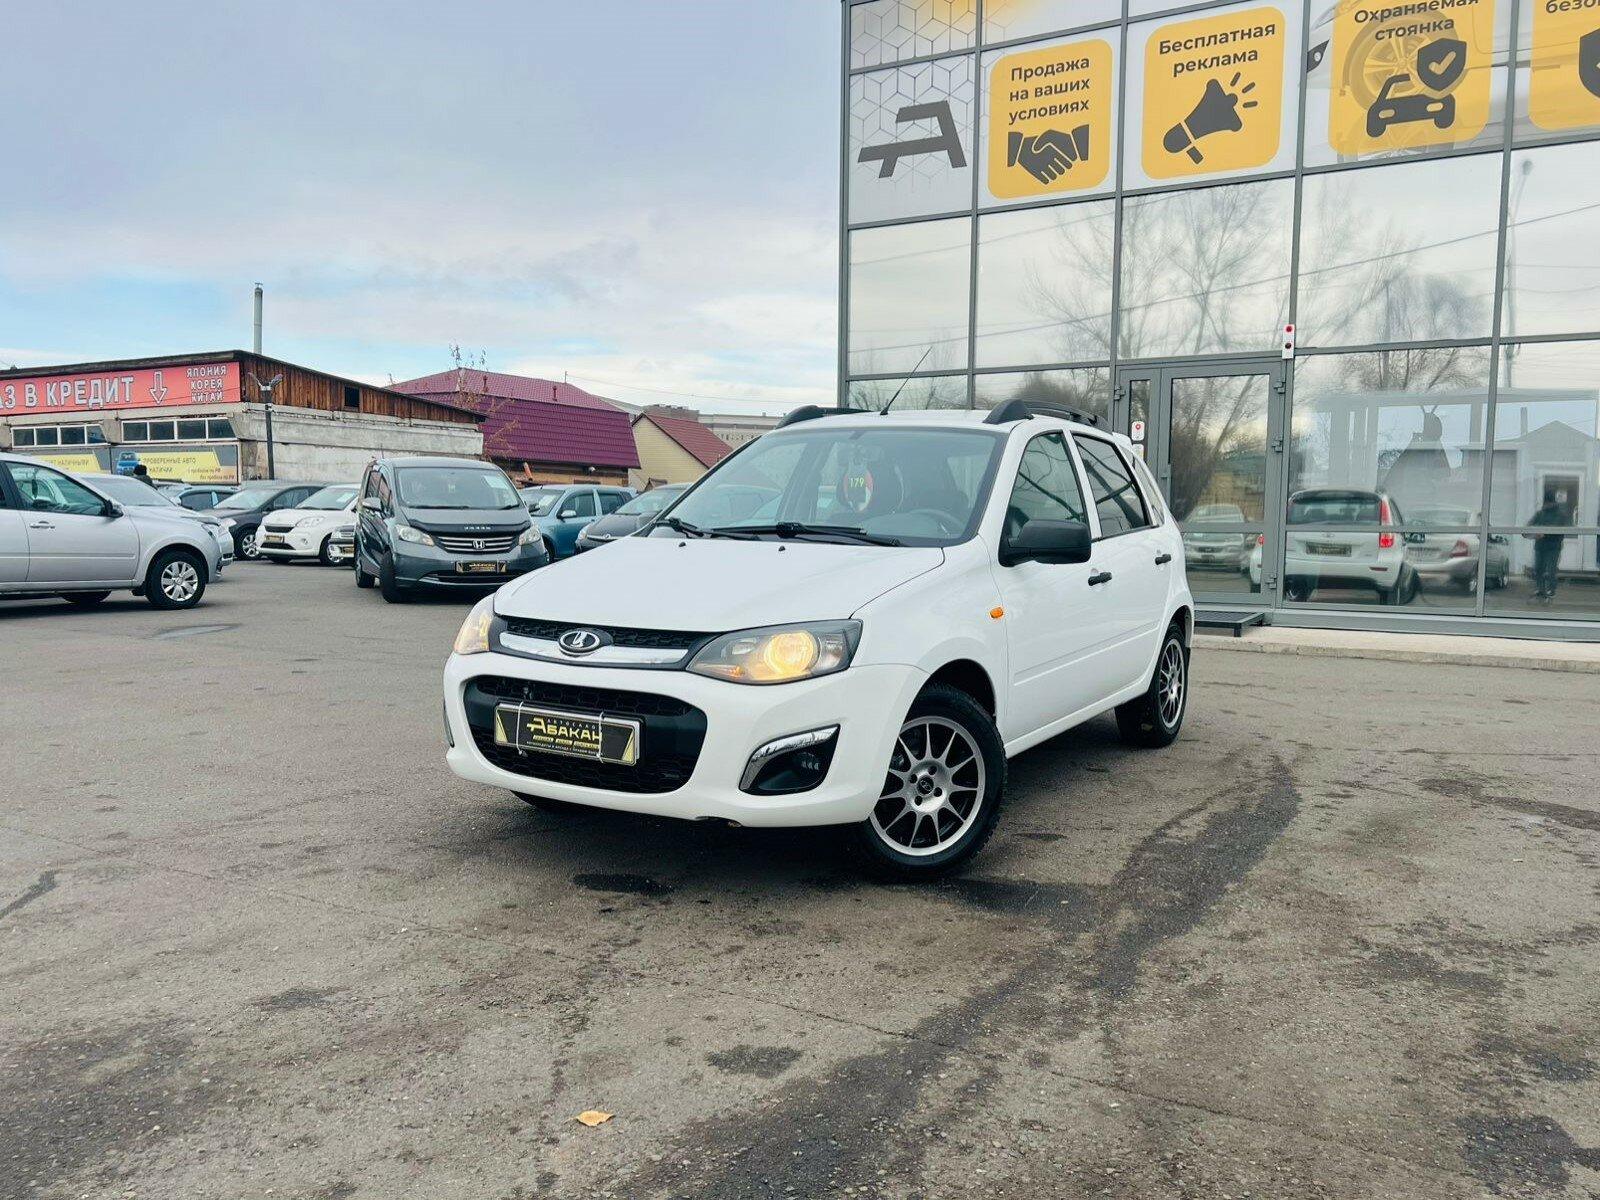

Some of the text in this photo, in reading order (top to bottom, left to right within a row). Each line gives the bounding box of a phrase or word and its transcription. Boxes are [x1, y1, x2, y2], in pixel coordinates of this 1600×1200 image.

[1545, 0, 1600, 14] безо
[1159, 23, 1276, 55] Бесплатная
[1375, 18, 1455, 41] стоянка
[1011, 57, 1090, 82] Продажа
[1173, 49, 1258, 78] реклама
[1009, 78, 1090, 102] на ваших
[1008, 99, 1090, 126] условиях
[186, 365, 227, 378] ЯПОНИЯ
[0, 377, 134, 409] З В КРЕДИТ
[191, 379, 224, 390] КОРЕЯ
[191, 391, 224, 402] КИТАЙ
[850, 477, 864, 488] 179
[547, 719, 598, 730] АВТОСАЛО
